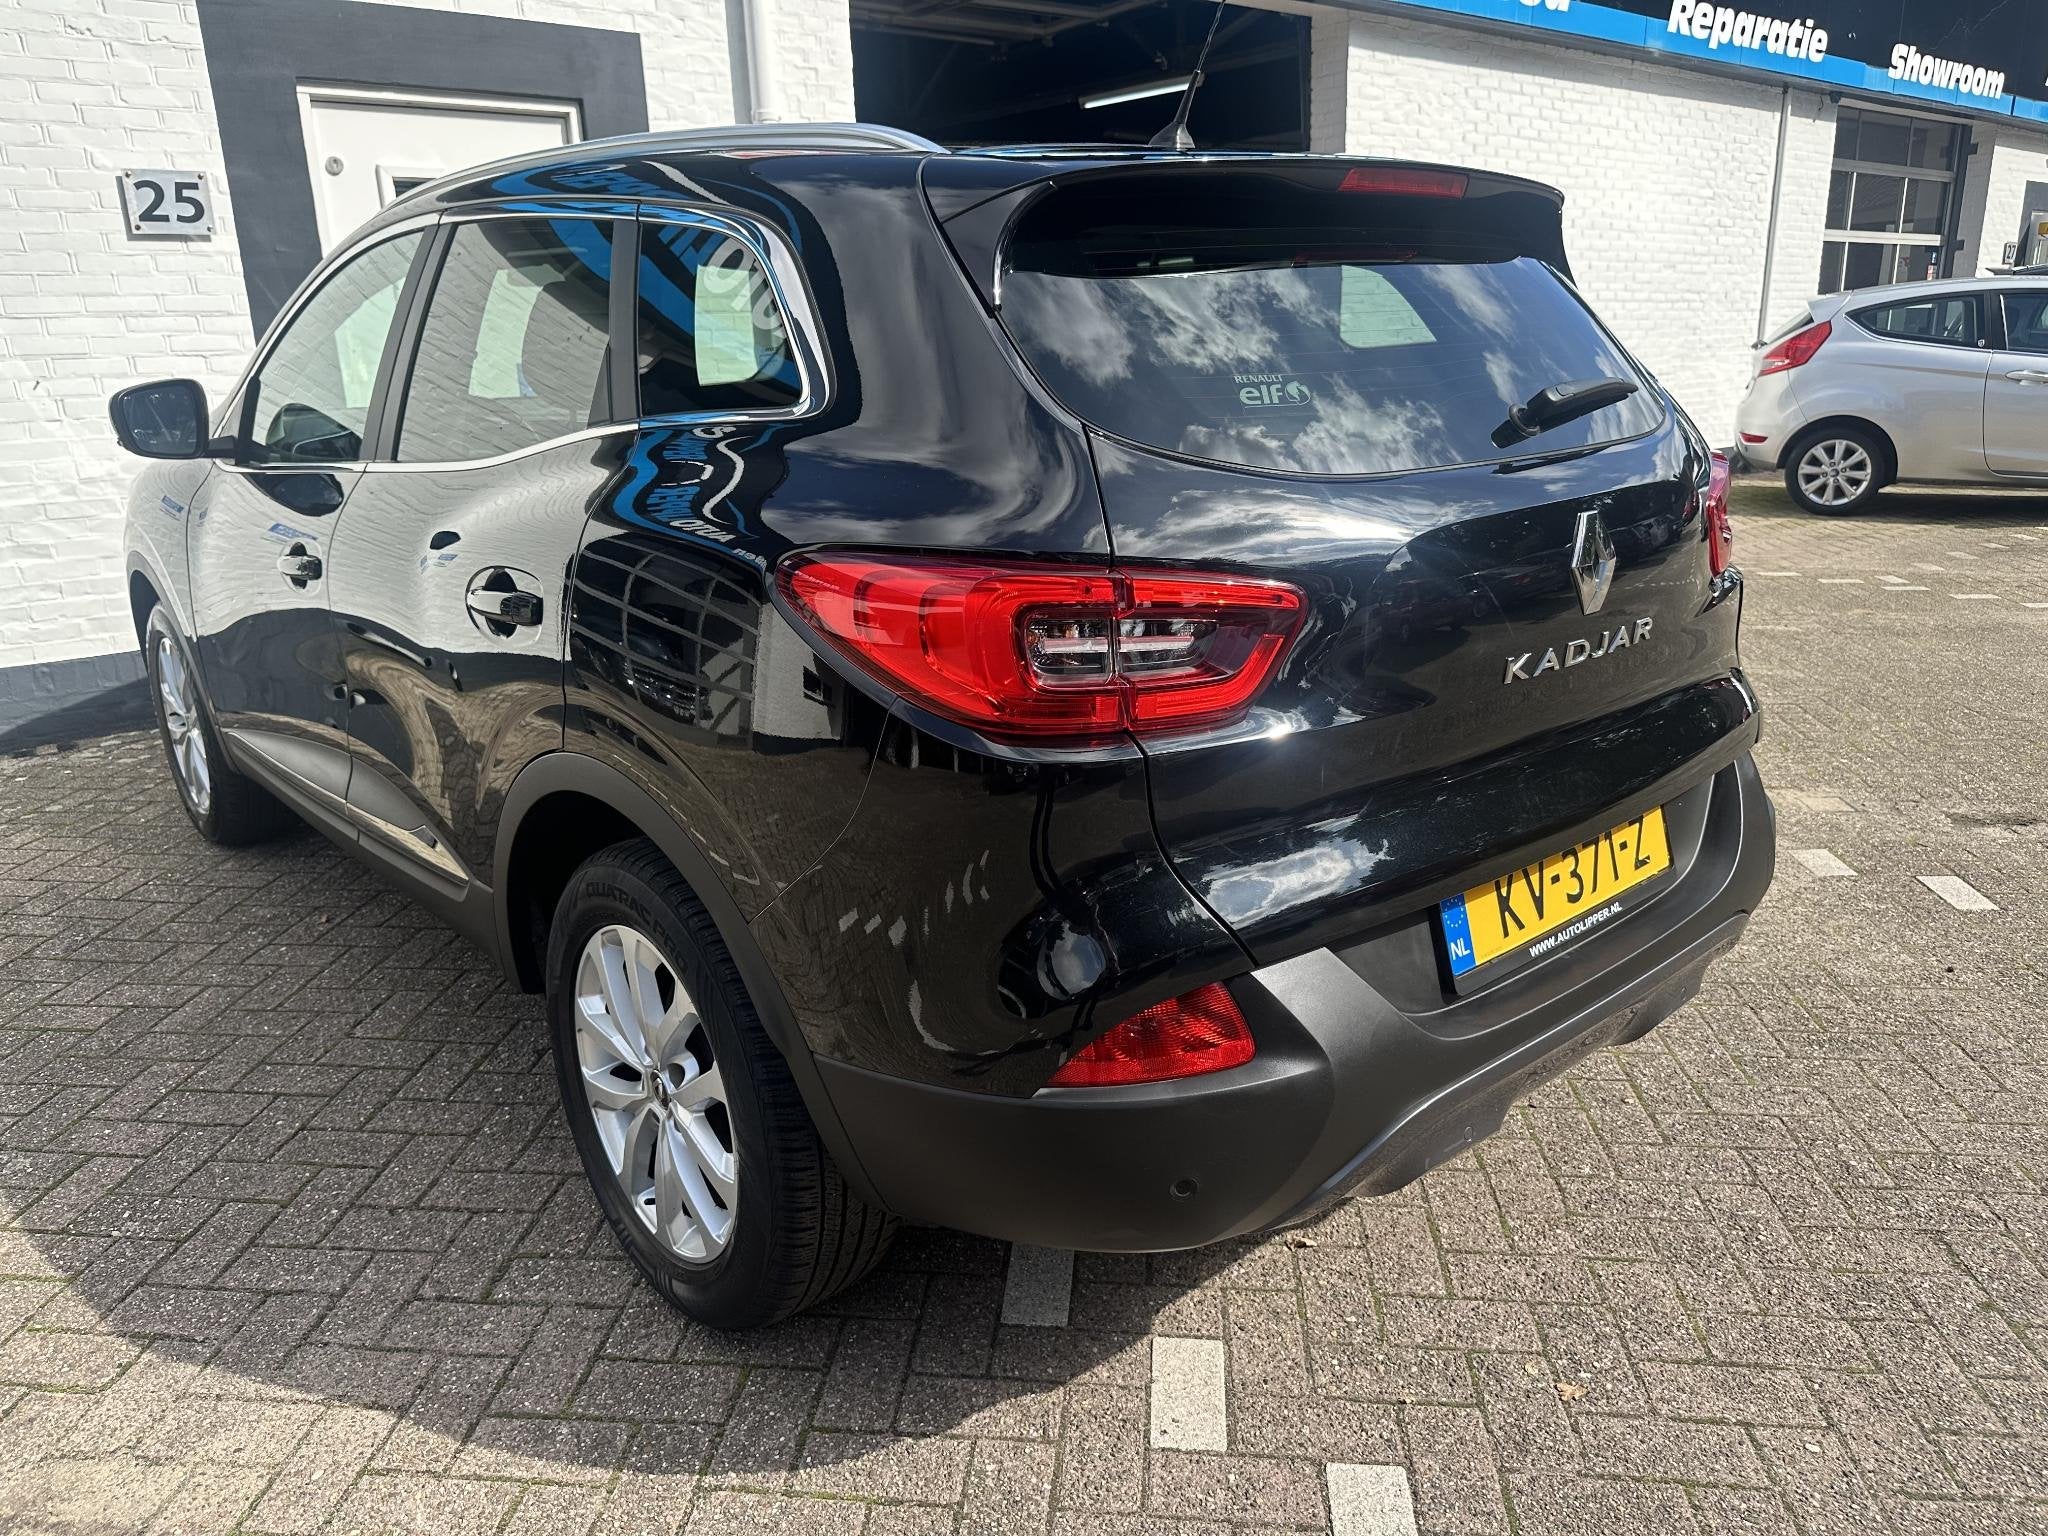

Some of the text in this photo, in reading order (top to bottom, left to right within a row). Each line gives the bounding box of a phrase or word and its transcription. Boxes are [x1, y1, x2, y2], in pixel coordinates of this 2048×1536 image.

[1667, 0, 1829, 62] Reparatie
[1888, 43, 2005, 99] Showroom
[133, 180, 205, 223] 25
[2006, 244, 2017, 260] 27
[1234, 374, 1283, 383] RENAULT
[1240, 384, 1283, 405] elf
[1503, 617, 1653, 685] KADJAR
[1494, 815, 1651, 938] KV-371-Z
[1450, 938, 1471, 960] NL
[1529, 901, 1623, 957] WWW.AUTOLIPPER.NL
